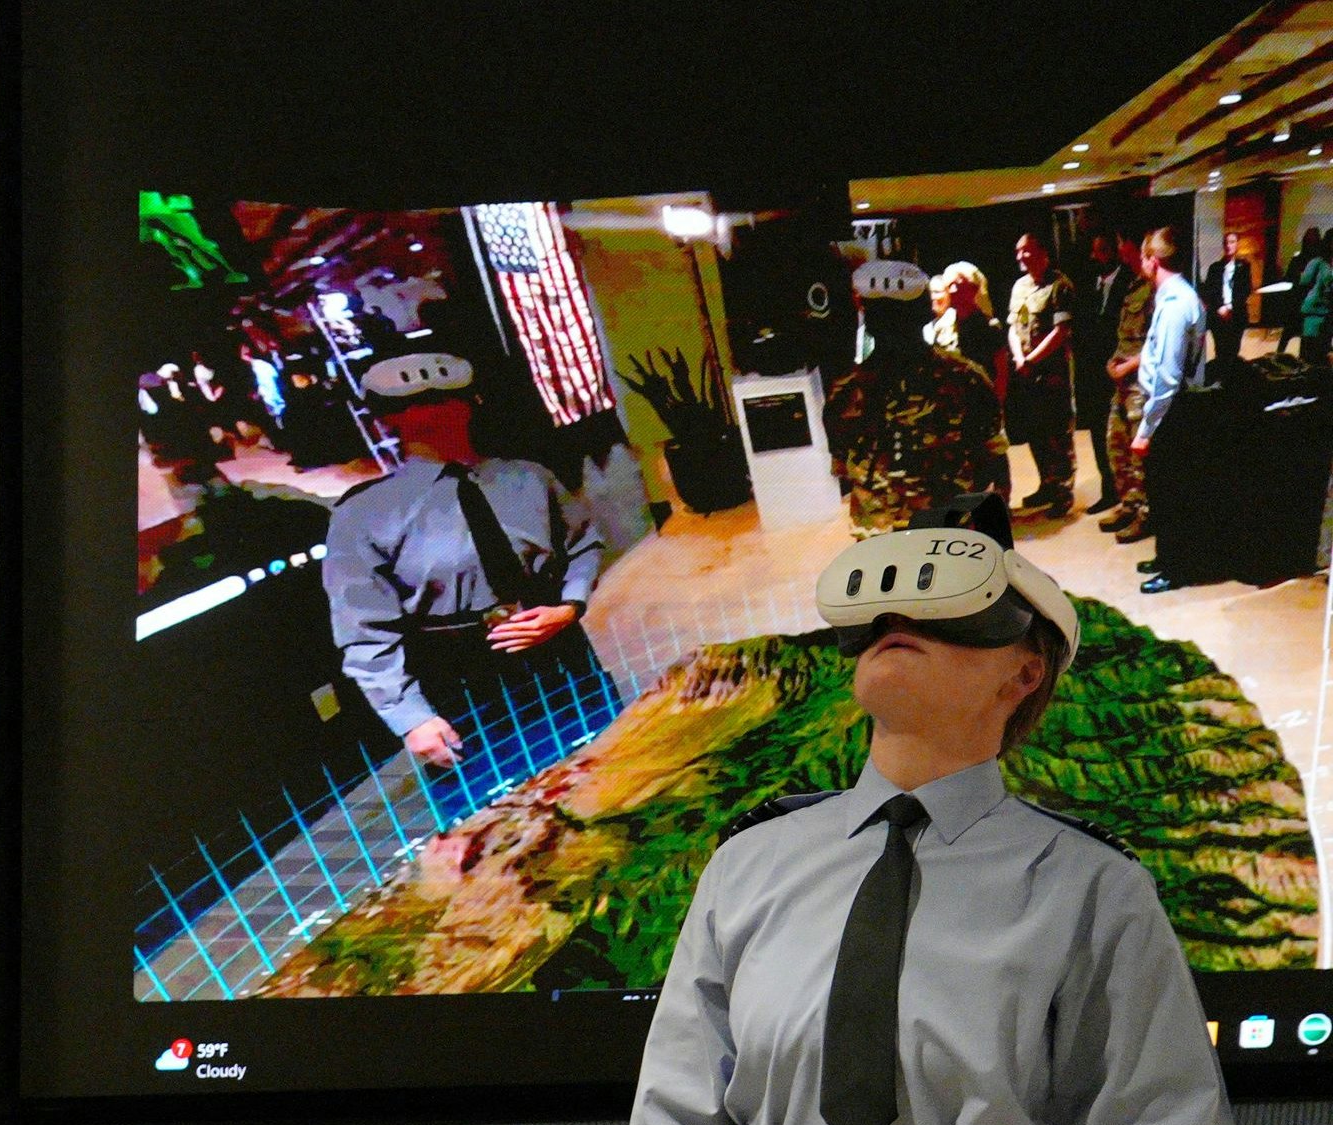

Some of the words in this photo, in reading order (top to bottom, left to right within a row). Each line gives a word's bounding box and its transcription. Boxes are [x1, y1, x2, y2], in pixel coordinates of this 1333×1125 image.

[926, 539, 987, 560] IC2
[196, 1042, 229, 1059] 59°F
[196, 1063, 247, 1081] Cloudy
